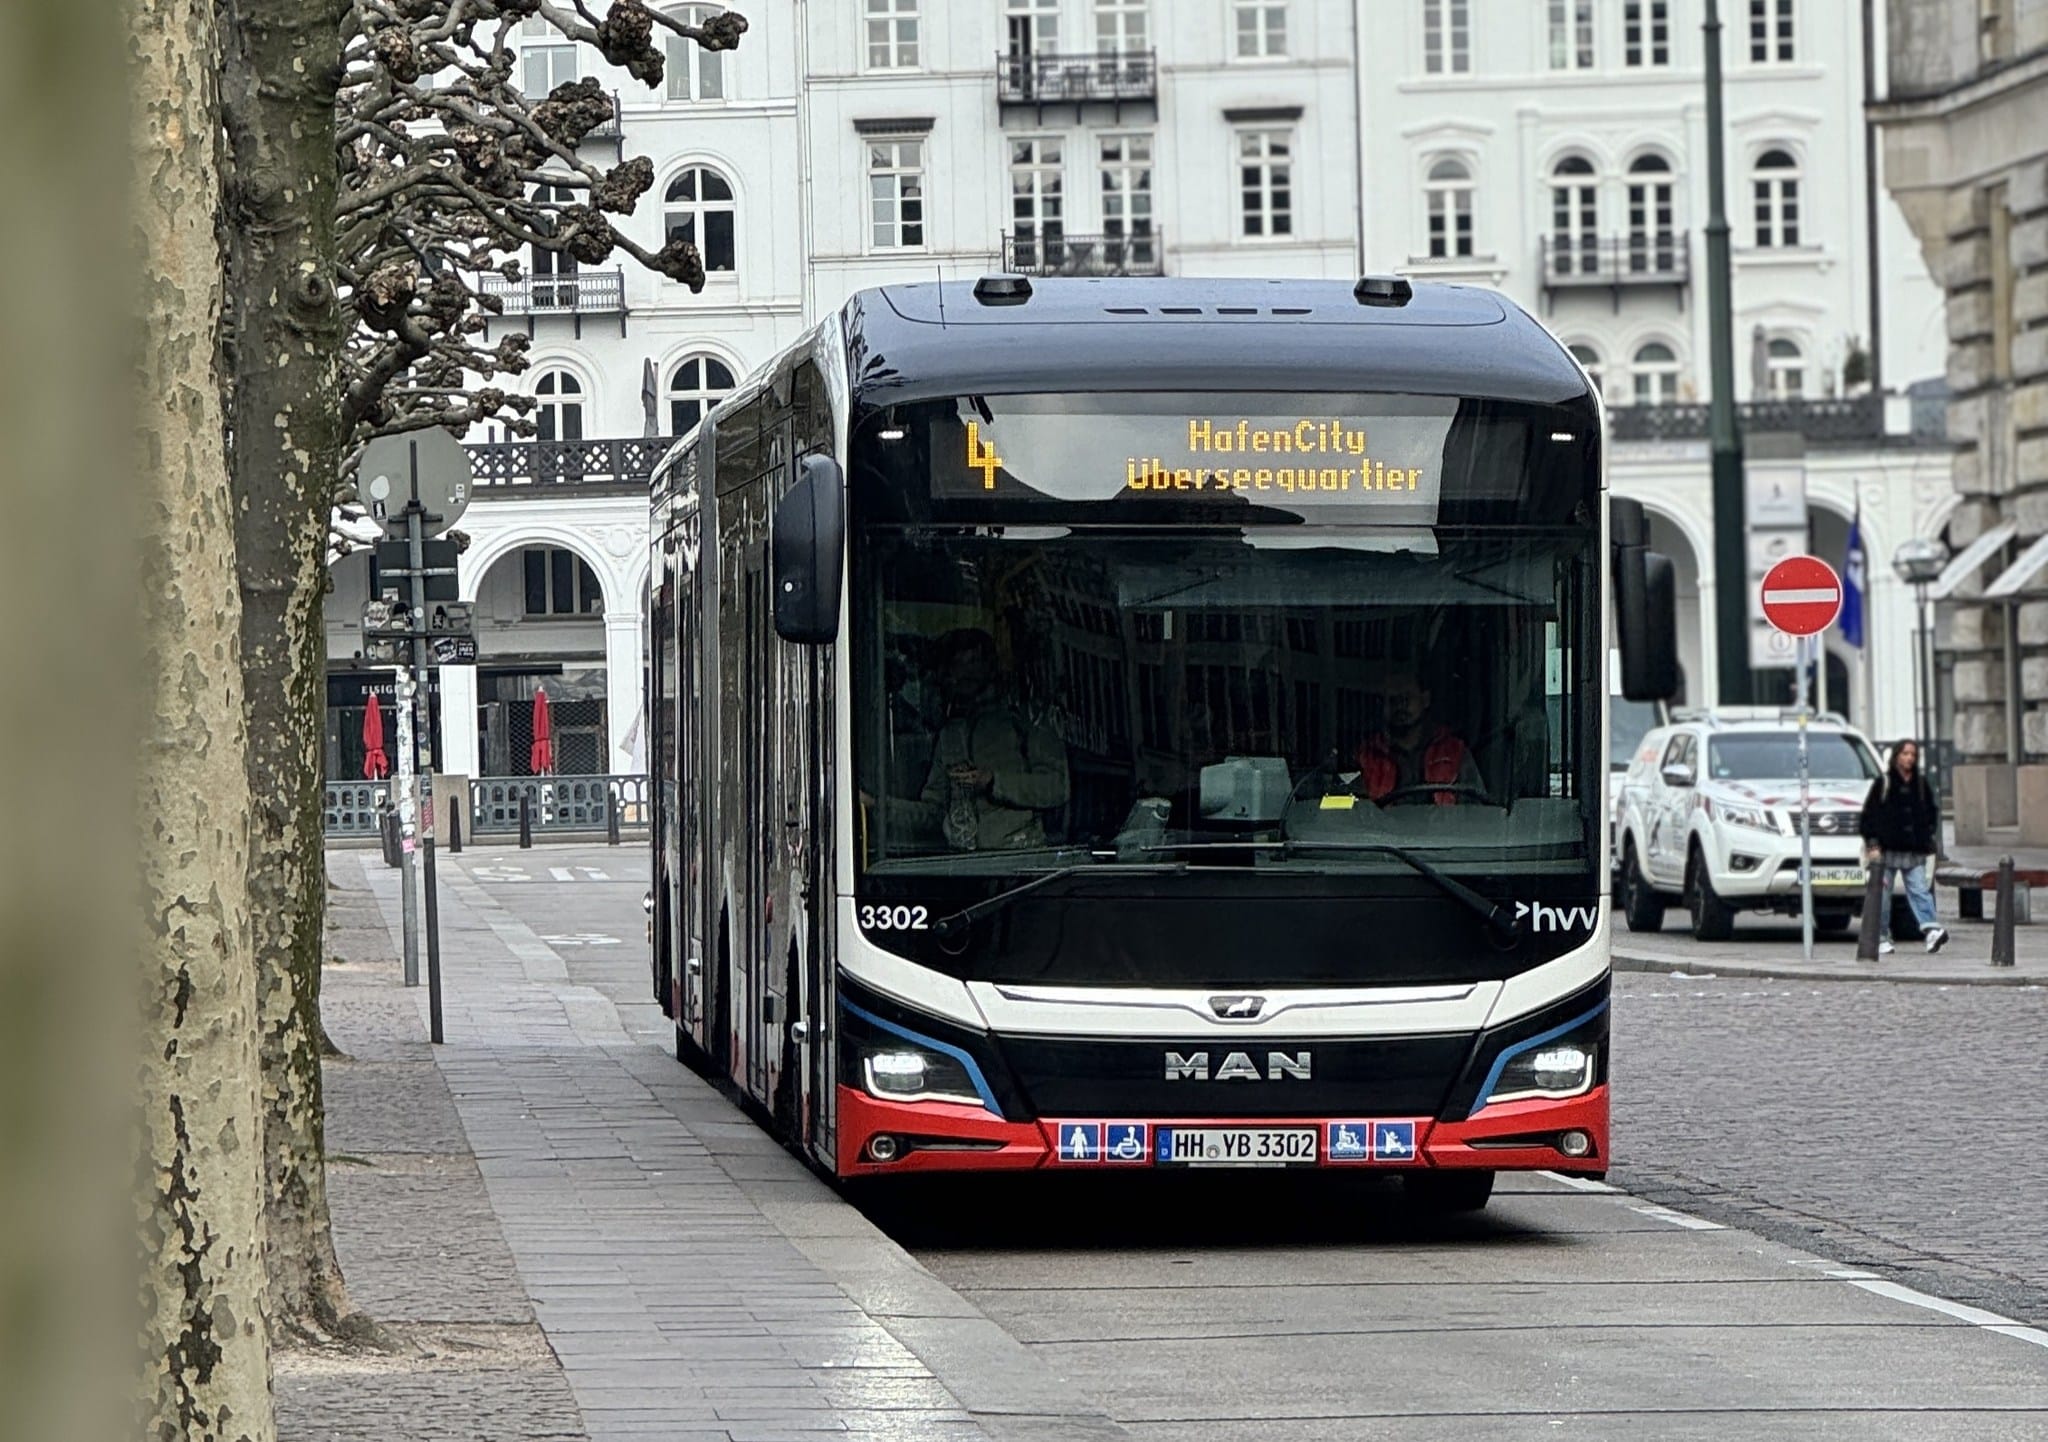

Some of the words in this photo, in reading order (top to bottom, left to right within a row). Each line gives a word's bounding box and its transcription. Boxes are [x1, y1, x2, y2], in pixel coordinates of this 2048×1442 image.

[1188, 419, 1365, 454] HafenCity
[966, 420, 1002, 490] 4
[1126, 457, 1423, 493] Überseequartier
[861, 905, 928, 930] 3302
[1165, 1052, 1311, 1080] MAN
[1175, 1133, 1204, 1157] HH
[1223, 1133, 1251, 1157] YB
[1257, 1133, 1314, 1157] 3302
